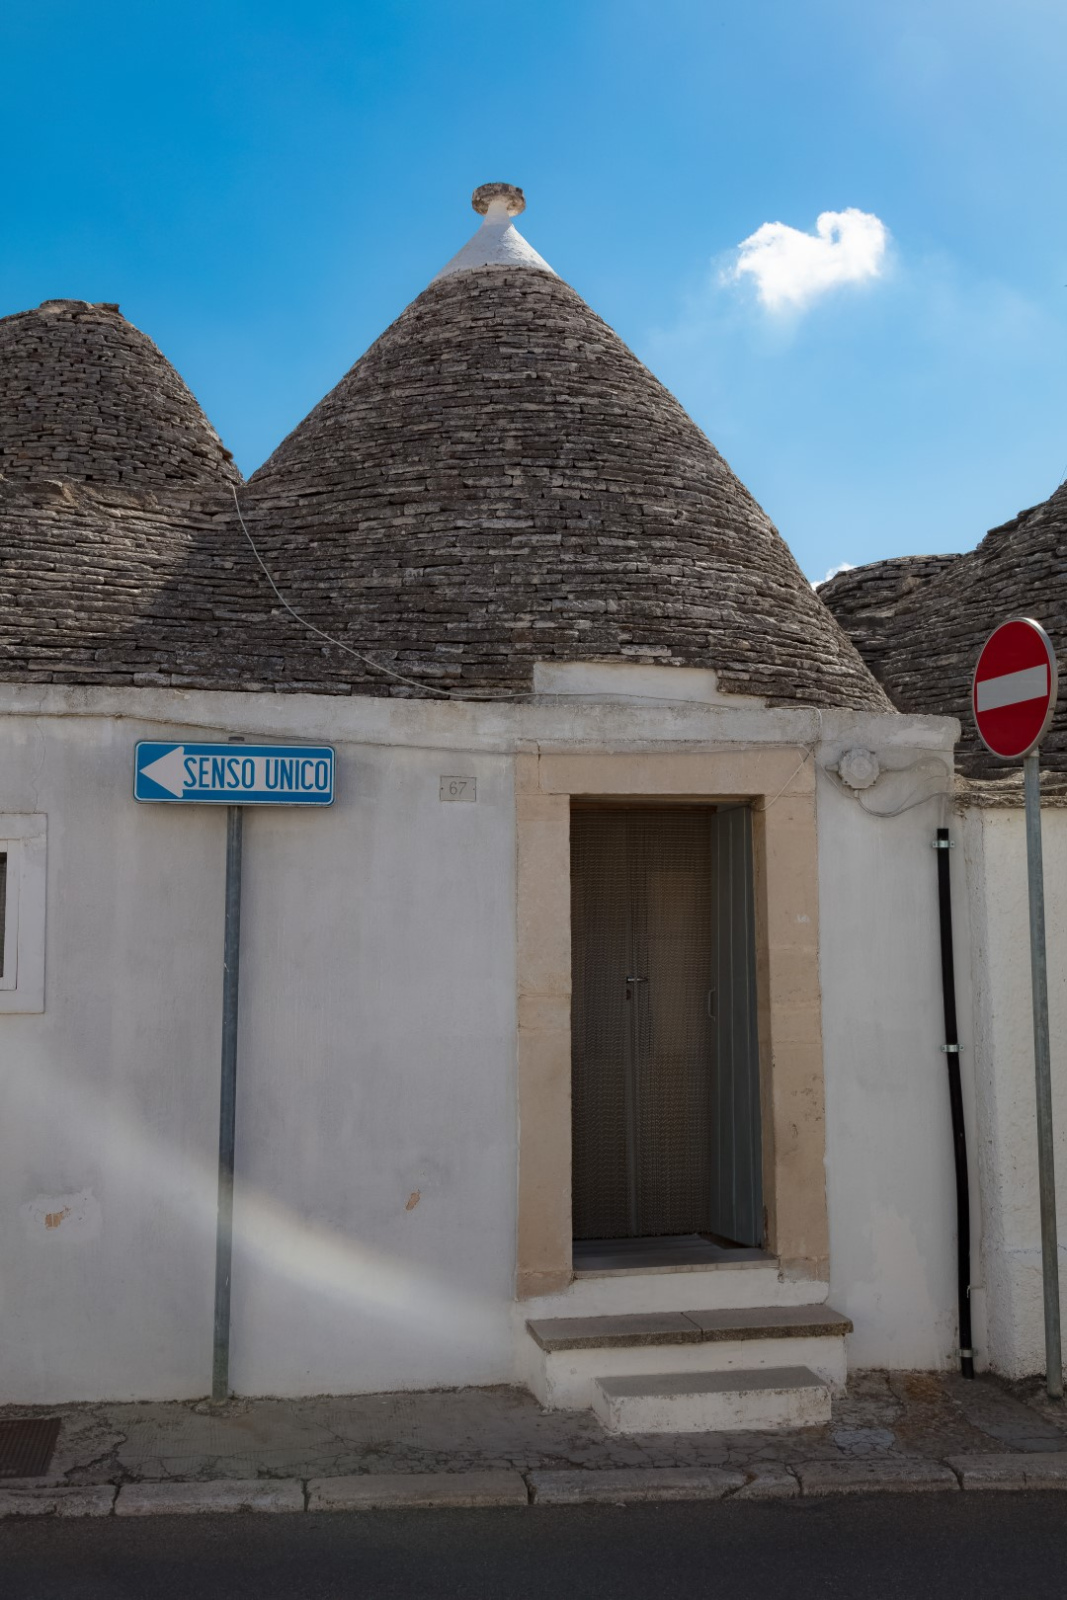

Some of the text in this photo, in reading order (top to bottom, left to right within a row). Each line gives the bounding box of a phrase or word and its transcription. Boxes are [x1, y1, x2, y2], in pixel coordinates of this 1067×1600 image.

[183, 757, 329, 791] SENSO UNICO
[449, 780, 467, 795] 67
